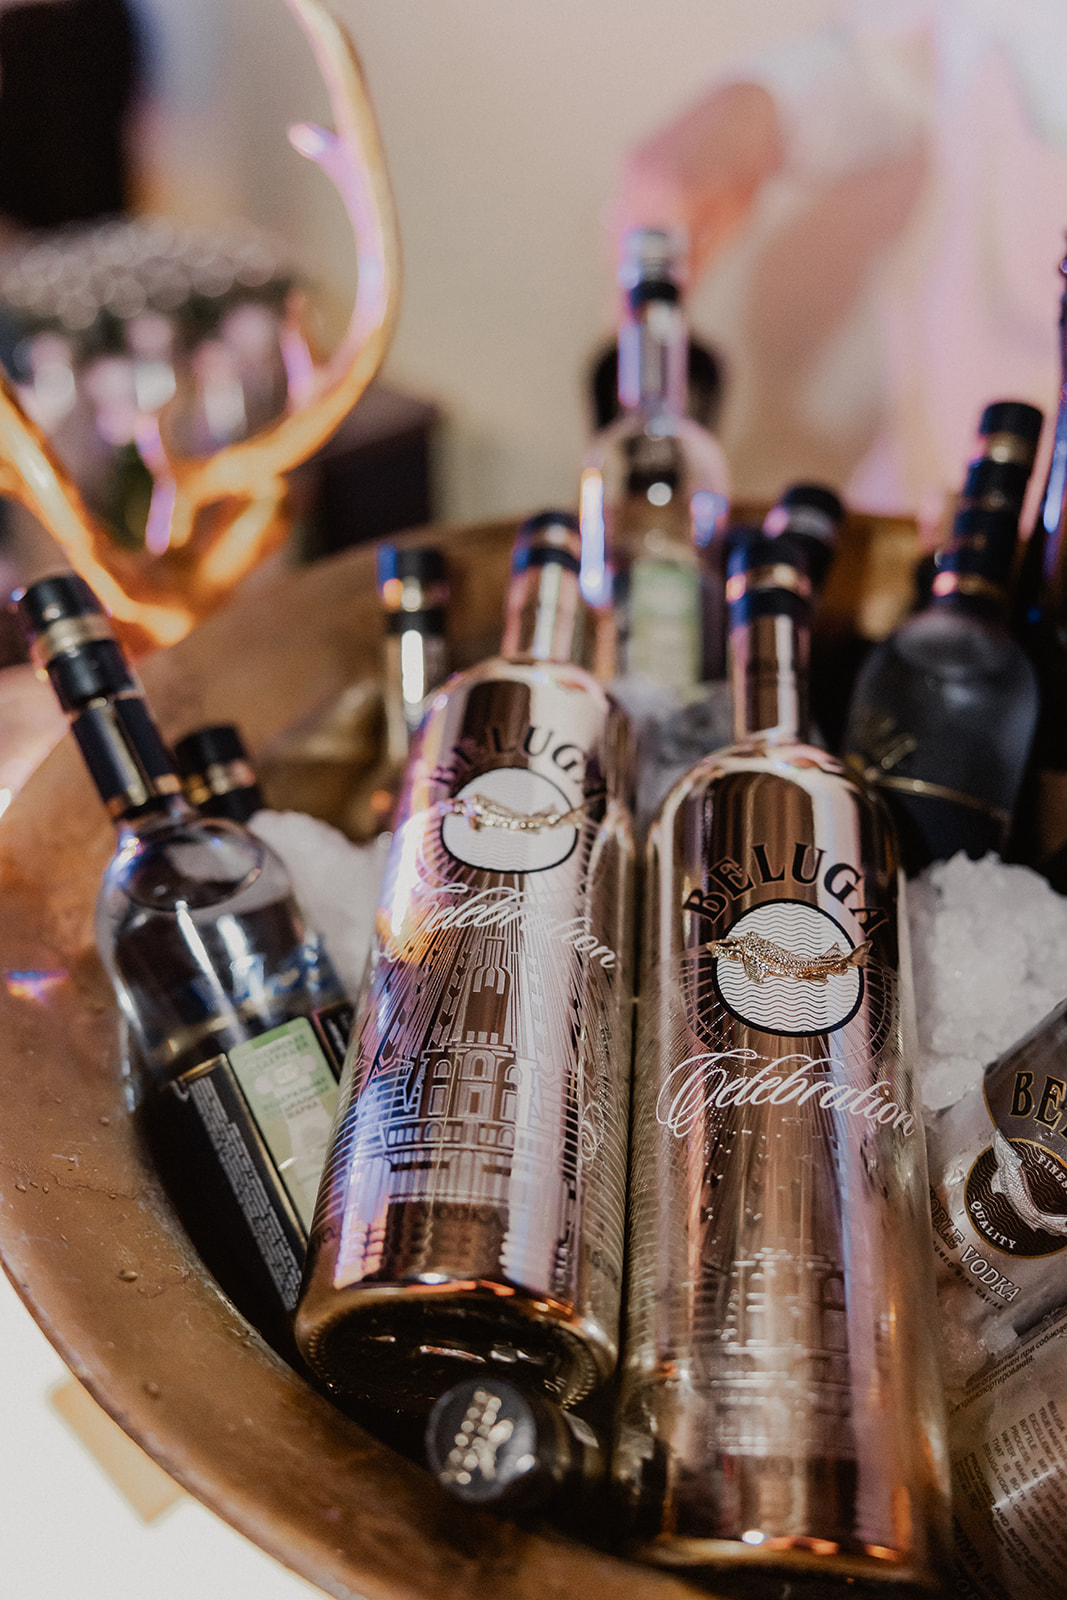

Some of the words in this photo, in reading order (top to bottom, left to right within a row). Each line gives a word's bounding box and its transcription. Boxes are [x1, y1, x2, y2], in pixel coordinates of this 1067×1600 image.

[682, 843, 888, 936] BELUGA
[656, 1048, 915, 1138] Celebration
[1008, 1070, 1067, 1141] BE
[1037, 1155, 1067, 1194] FINES
[929, 1183, 965, 1251] OBLE
[960, 1245, 1022, 1303] VODKA
[970, 1200, 1017, 1251] QUALITY
[1027, 1412, 1057, 1463] EXCELLENCE
[1037, 1406, 1051, 1428] TRUE
[1046, 1399, 1066, 1432] BELUGA
[981, 1442, 1000, 1474] BELUGA
[991, 1438, 1004, 1457] THAT
[1002, 1462, 1011, 1472] IS
[1008, 1476, 1026, 1501] BOTH
[999, 1430, 1016, 1458] WATER
[1013, 1460, 1029, 1483] MAKE
[968, 1451, 996, 1505] PRODUCED
[994, 1506, 1010, 1527] AND
